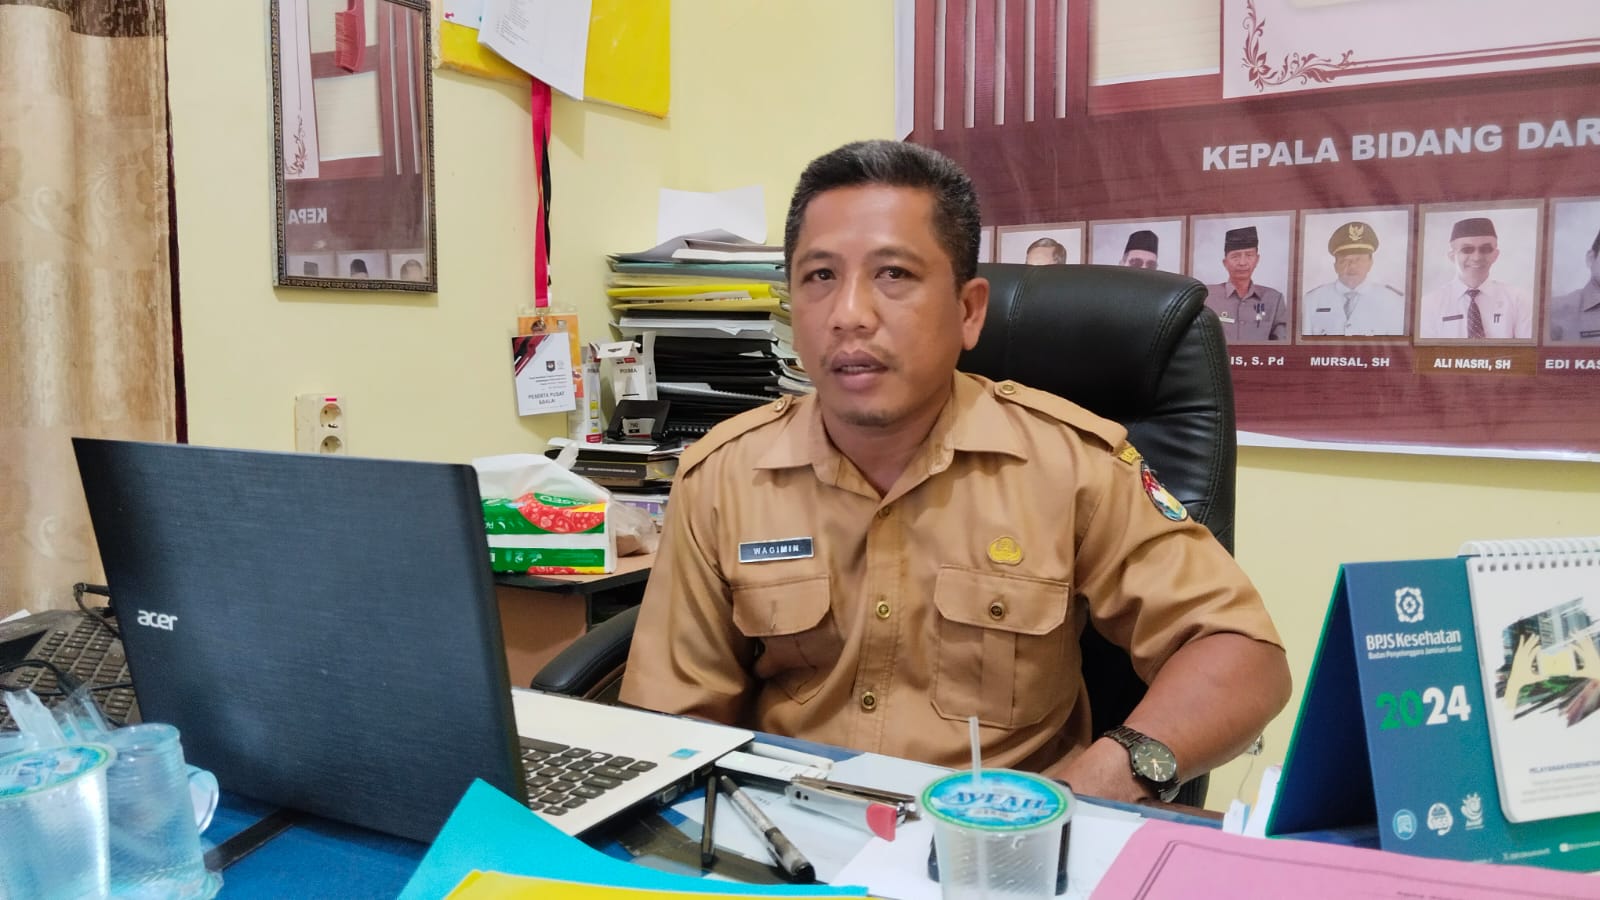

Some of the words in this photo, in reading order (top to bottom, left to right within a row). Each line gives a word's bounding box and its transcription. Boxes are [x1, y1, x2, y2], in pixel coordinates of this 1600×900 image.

[1202, 138, 1340, 171] KEPALA
[1351, 124, 1502, 161] BIDANG
[1518, 117, 1600, 150] DAR
[1268, 357, 1285, 366] Pd
[1310, 357, 1368, 368] MURSAL,
[1371, 357, 1390, 367] SH
[1433, 358, 1452, 369] ALI
[1455, 358, 1492, 371] NASRI,
[1495, 359, 1512, 370] SH
[1545, 359, 1570, 369] EDI
[753, 544, 800, 555] WAGIMIN
[137, 610, 178, 631] acer
[1366, 633, 1395, 650] BPJS
[1395, 630, 1461, 647] Kesehatan
[1376, 685, 1472, 731] 2024
